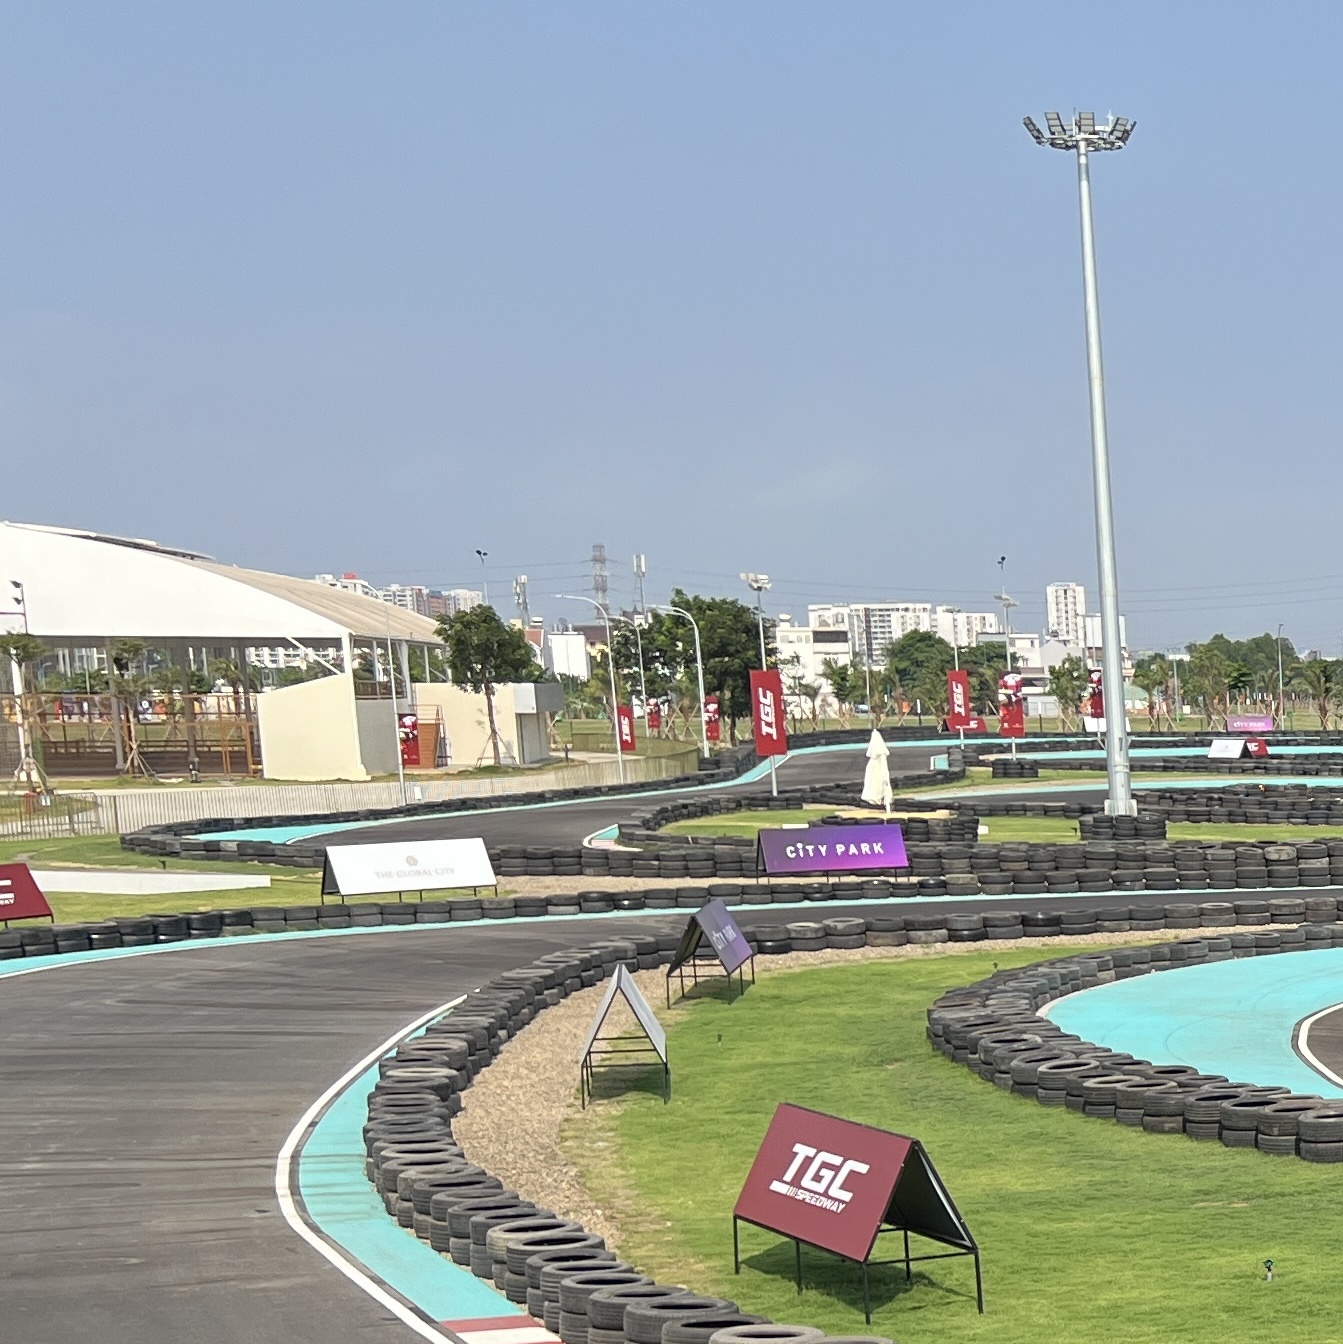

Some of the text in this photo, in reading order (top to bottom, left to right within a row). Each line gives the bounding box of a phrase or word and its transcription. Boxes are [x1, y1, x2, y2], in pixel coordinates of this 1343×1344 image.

[758, 687, 776, 740] TGC
[835, 842, 884, 856] PARK
[396, 868, 432, 879] GLOBAL
[783, 1143, 870, 1203] TGC
[796, 1188, 847, 1214] SPEEDWAY
